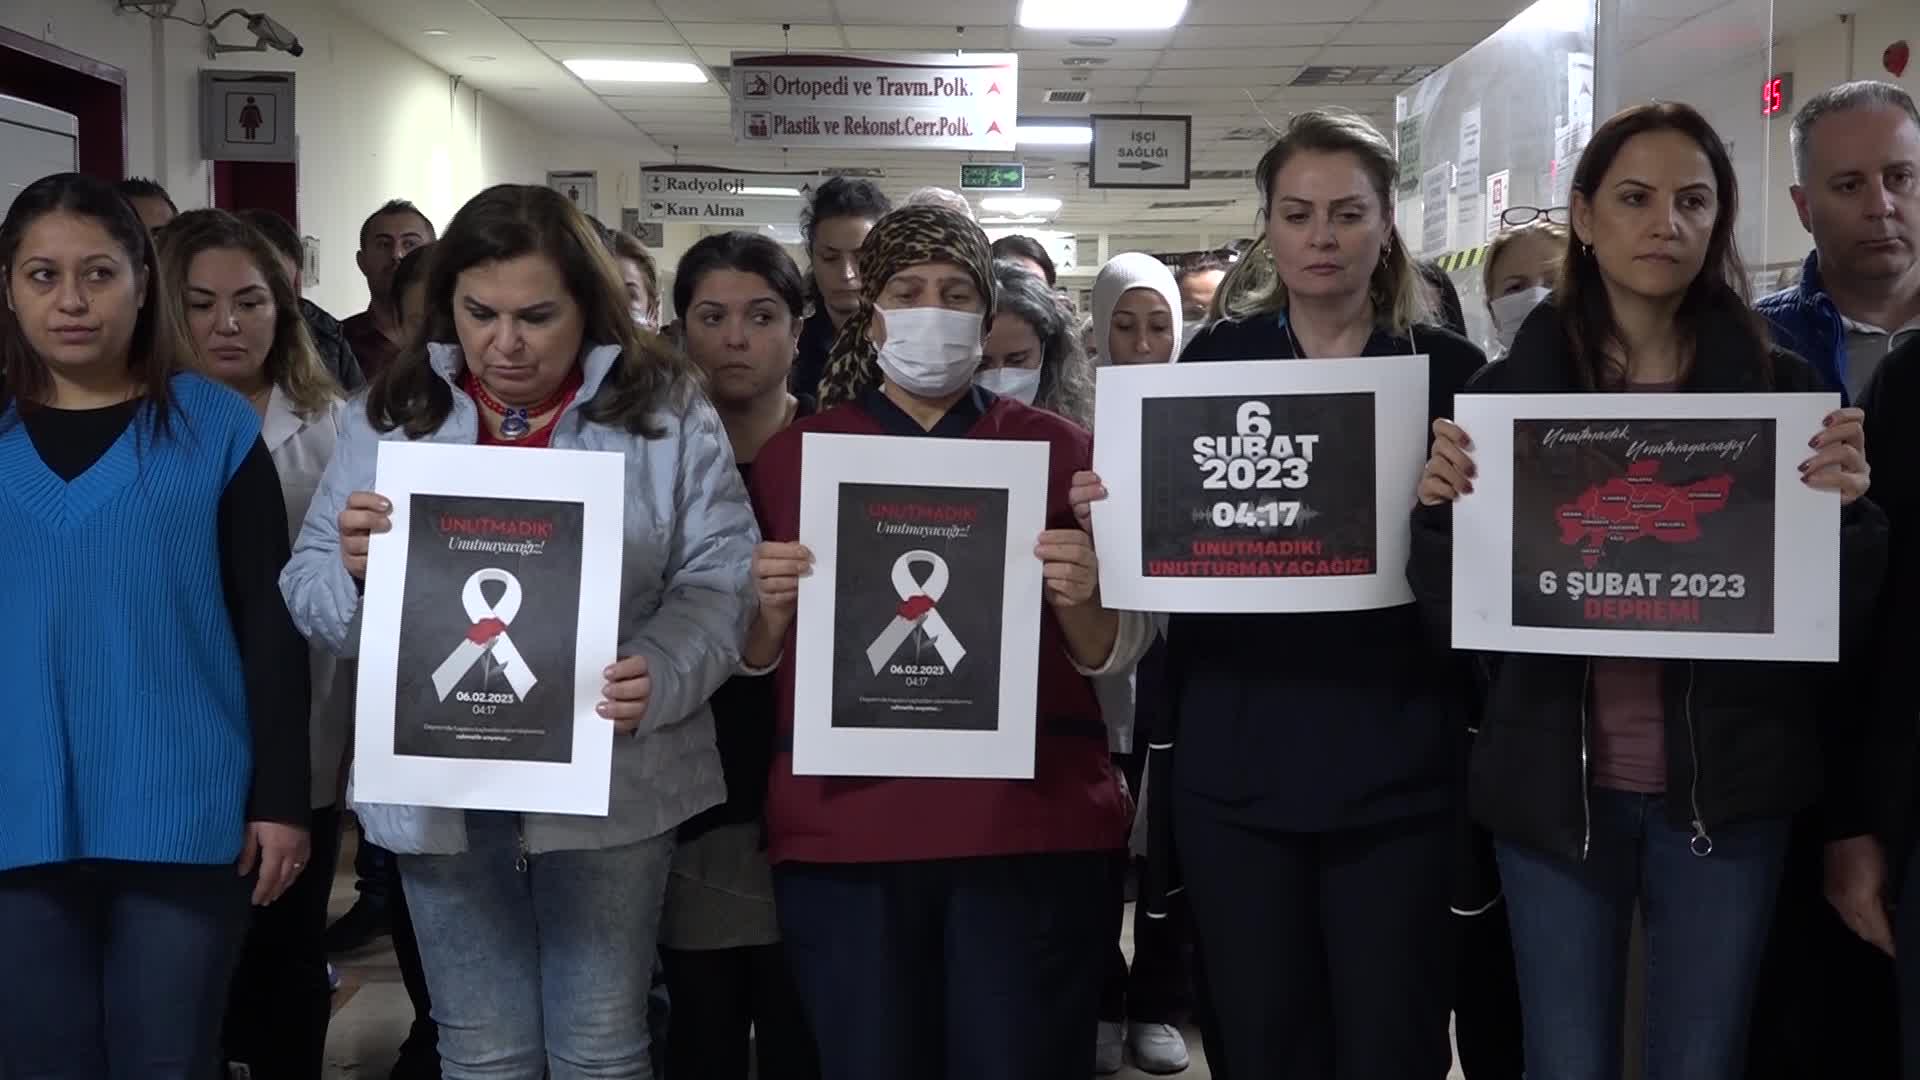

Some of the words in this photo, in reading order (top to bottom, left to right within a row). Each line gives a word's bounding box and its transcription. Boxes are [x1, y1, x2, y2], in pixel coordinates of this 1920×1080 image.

[774, 75, 848, 99] Ortopedi
[853, 83, 872, 96] ve
[877, 76, 973, 97] Travm.Polk.
[774, 115, 820, 136] Plastik
[824, 121, 840, 136] ve
[844, 116, 973, 137] Rekonst.Cerr.Polk.
[1118, 146, 1168, 158] SAĞLIĞI
[666, 177, 744, 195] Radyoloji
[666, 203, 698, 216] Kan
[703, 204, 744, 217] Alma
[1236, 400, 1272, 438] 6
[1203, 457, 1309, 489] 2023
[1212, 501, 1300, 527] 04:17
[1192, 539, 1322, 556] UNUTMADIK!
[1149, 556, 1370, 576] UNUTTURMAYACAĞIZ!
[1539, 571, 1558, 594] 6
[1566, 572, 1662, 600] ŞUBAT
[1670, 573, 1746, 598] 2023
[890, 665, 945, 675] 06.02.2023
[455, 691, 514, 703] 06.02.2023
